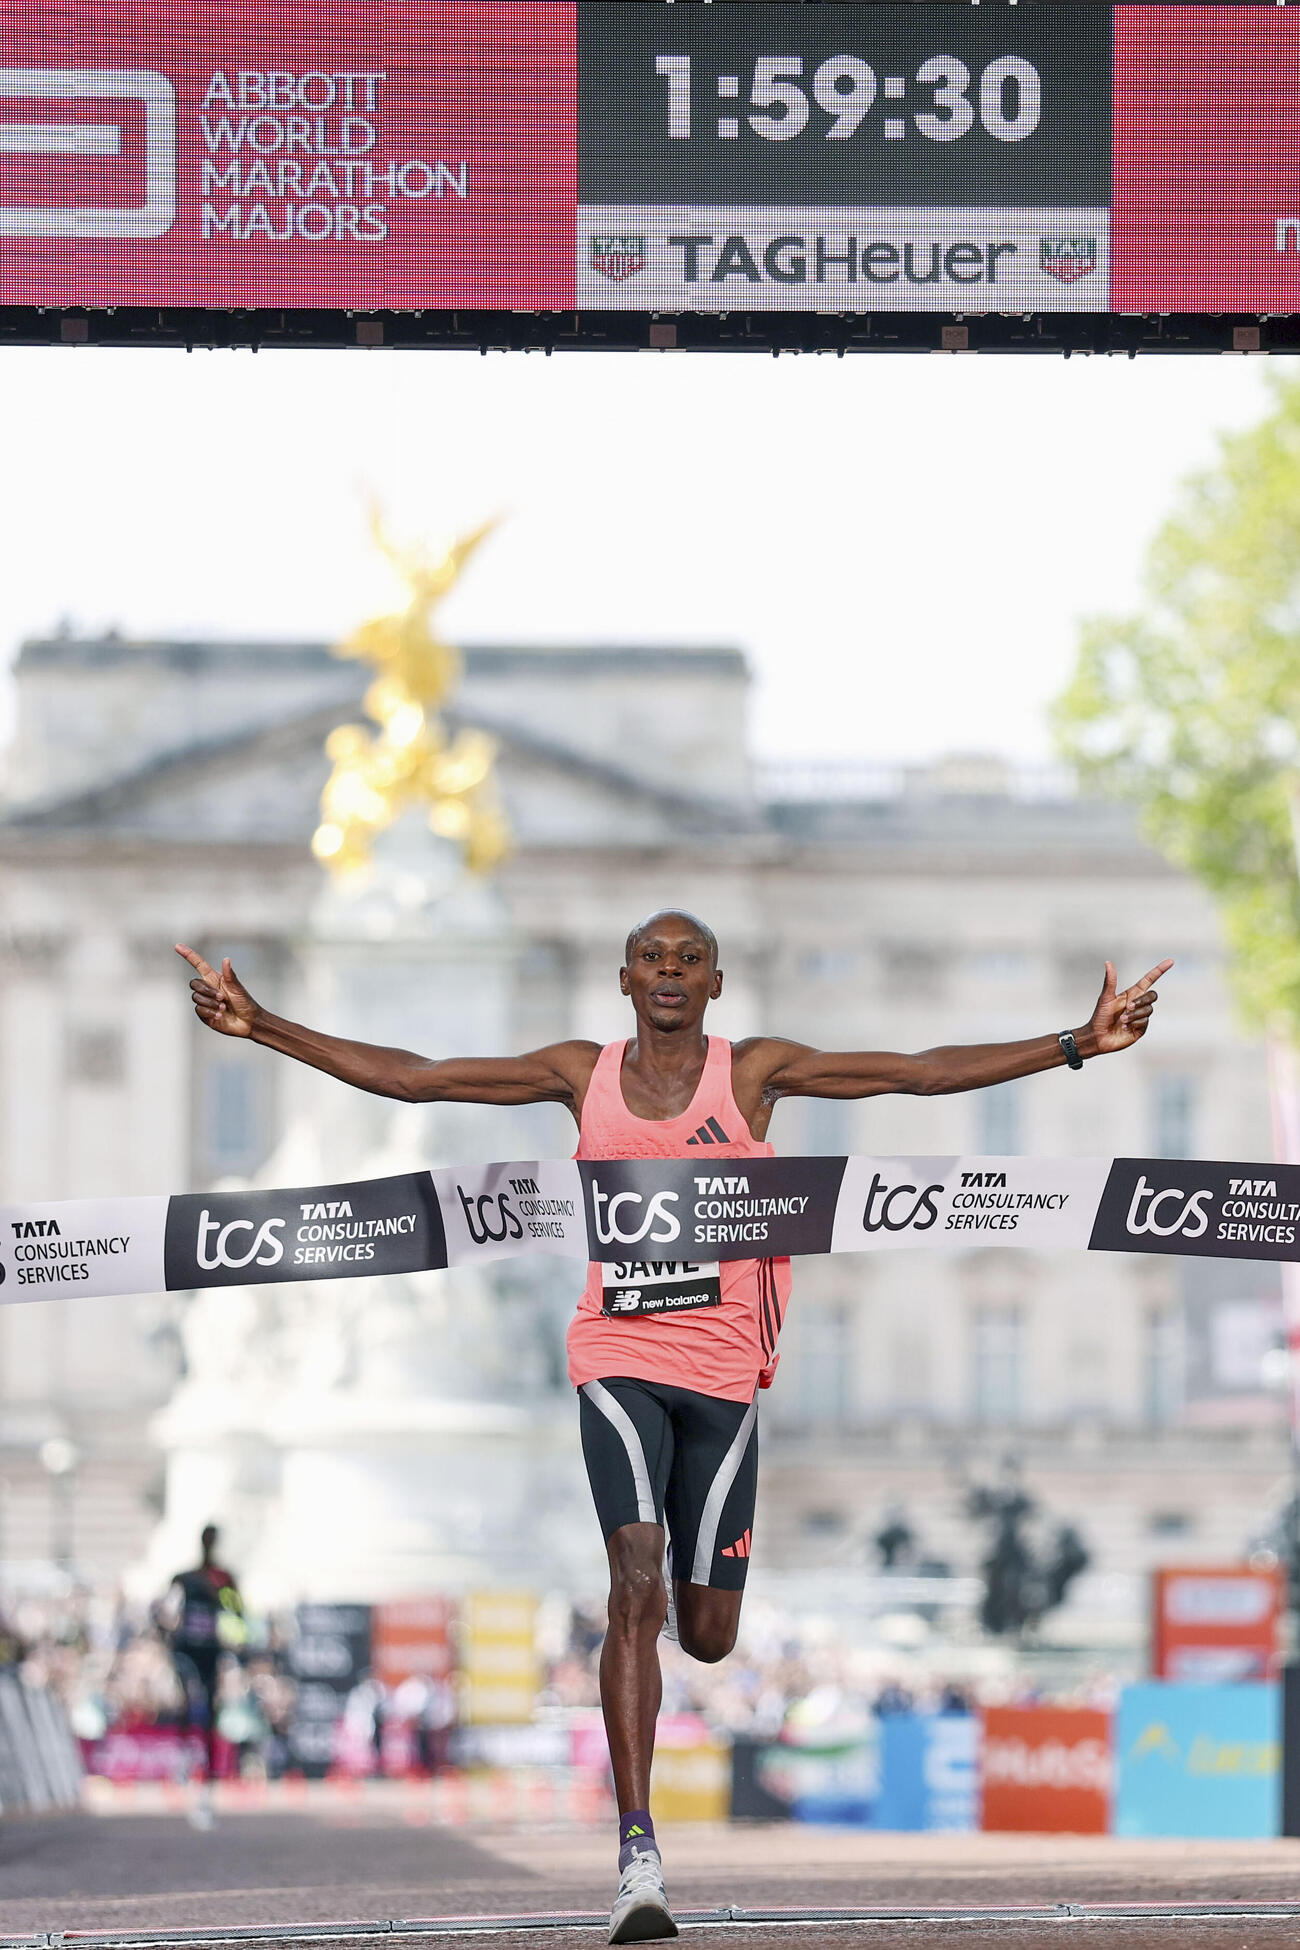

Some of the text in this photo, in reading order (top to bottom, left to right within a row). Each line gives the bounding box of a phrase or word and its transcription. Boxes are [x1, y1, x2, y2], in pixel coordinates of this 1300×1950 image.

[202, 71, 387, 112] ABBOTT
[656, 54, 1041, 142] 1:59:30
[199, 116, 378, 154] WORLD
[200, 158, 470, 198] MARATHON
[200, 202, 390, 241] MAJORS
[508, 1178, 540, 1194] TATA
[694, 1176, 750, 1195] TATA
[960, 1173, 1007, 1187] TATA
[1228, 1179, 1277, 1197] TATA
[300, 1201, 353, 1220] TATA
[519, 1199, 575, 1216] CONSULTANCY
[592, 1179, 681, 1244] tcs
[694, 1196, 809, 1219] CONSULTANCY
[863, 1173, 945, 1232] tcs
[952, 1193, 1069, 1209] CONSULTANCY
[1125, 1175, 1214, 1237] tcs
[457, 1185, 523, 1244] tcs
[945, 1214, 1020, 1230] SERVICES
[11, 1220, 61, 1238] TATA
[297, 1215, 417, 1242] CONSULTANCY
[527, 1222, 565, 1238] SERVICES
[694, 1222, 769, 1243] SERVICES
[1216, 1222, 1296, 1243] SERVICES
[14, 1237, 130, 1261] CONSULTANCY
[196, 1209, 286, 1270] tcs
[294, 1243, 376, 1264] SERVICES
[17, 1263, 89, 1284] SERVICES
[642, 1299, 664, 1309] new
[665, 1293, 710, 1306] balance
